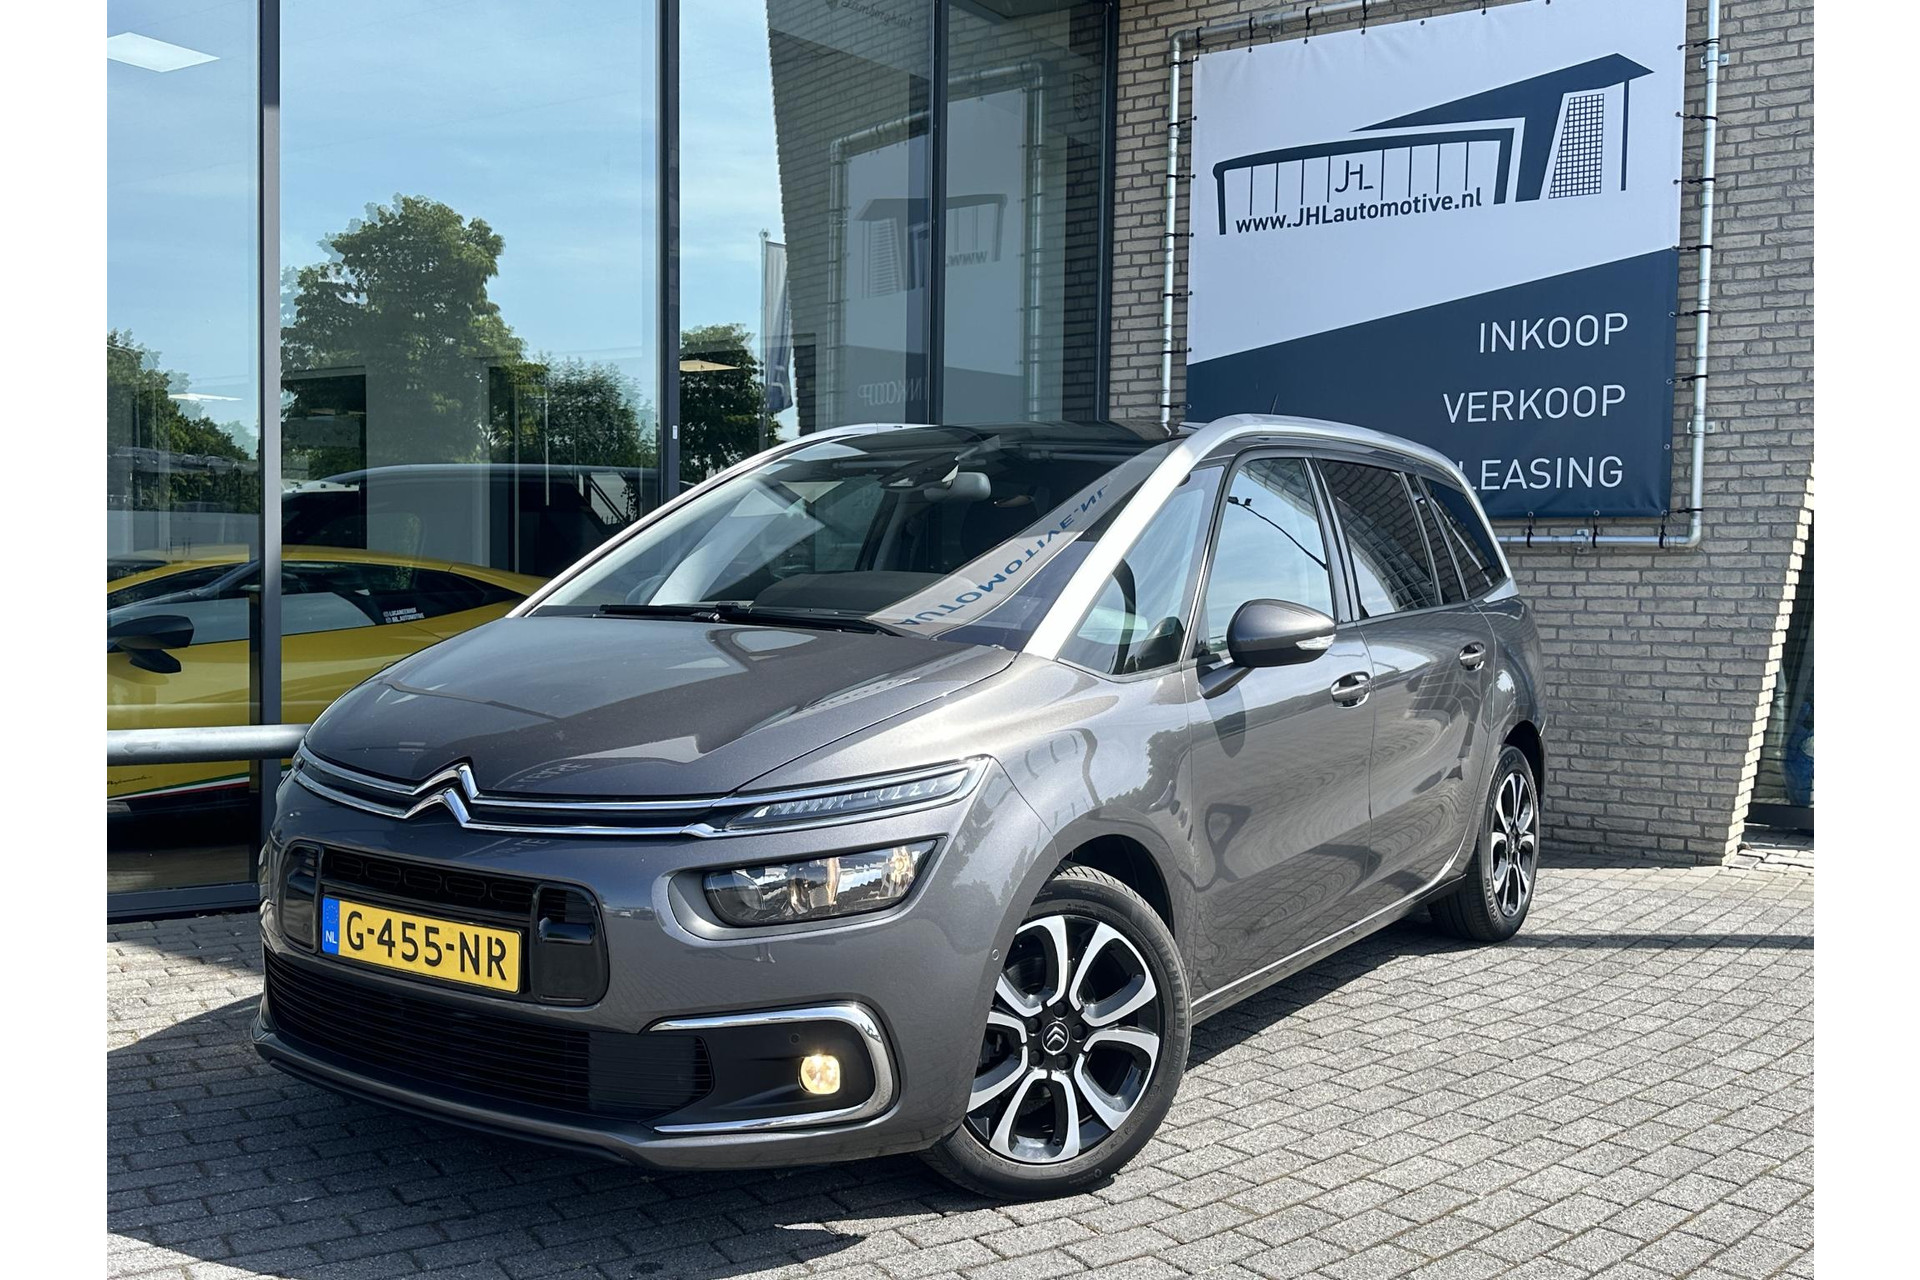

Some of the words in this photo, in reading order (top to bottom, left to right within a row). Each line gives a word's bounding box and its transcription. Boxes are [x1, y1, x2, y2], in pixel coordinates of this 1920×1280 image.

[1235, 187, 1482, 234] www.JHLautomotive.nl
[1478, 312, 1628, 354] INKOOP
[1443, 384, 1626, 424] VERKOOP
[325, 929, 338, 945] NL
[346, 910, 507, 981] G-455-NR
